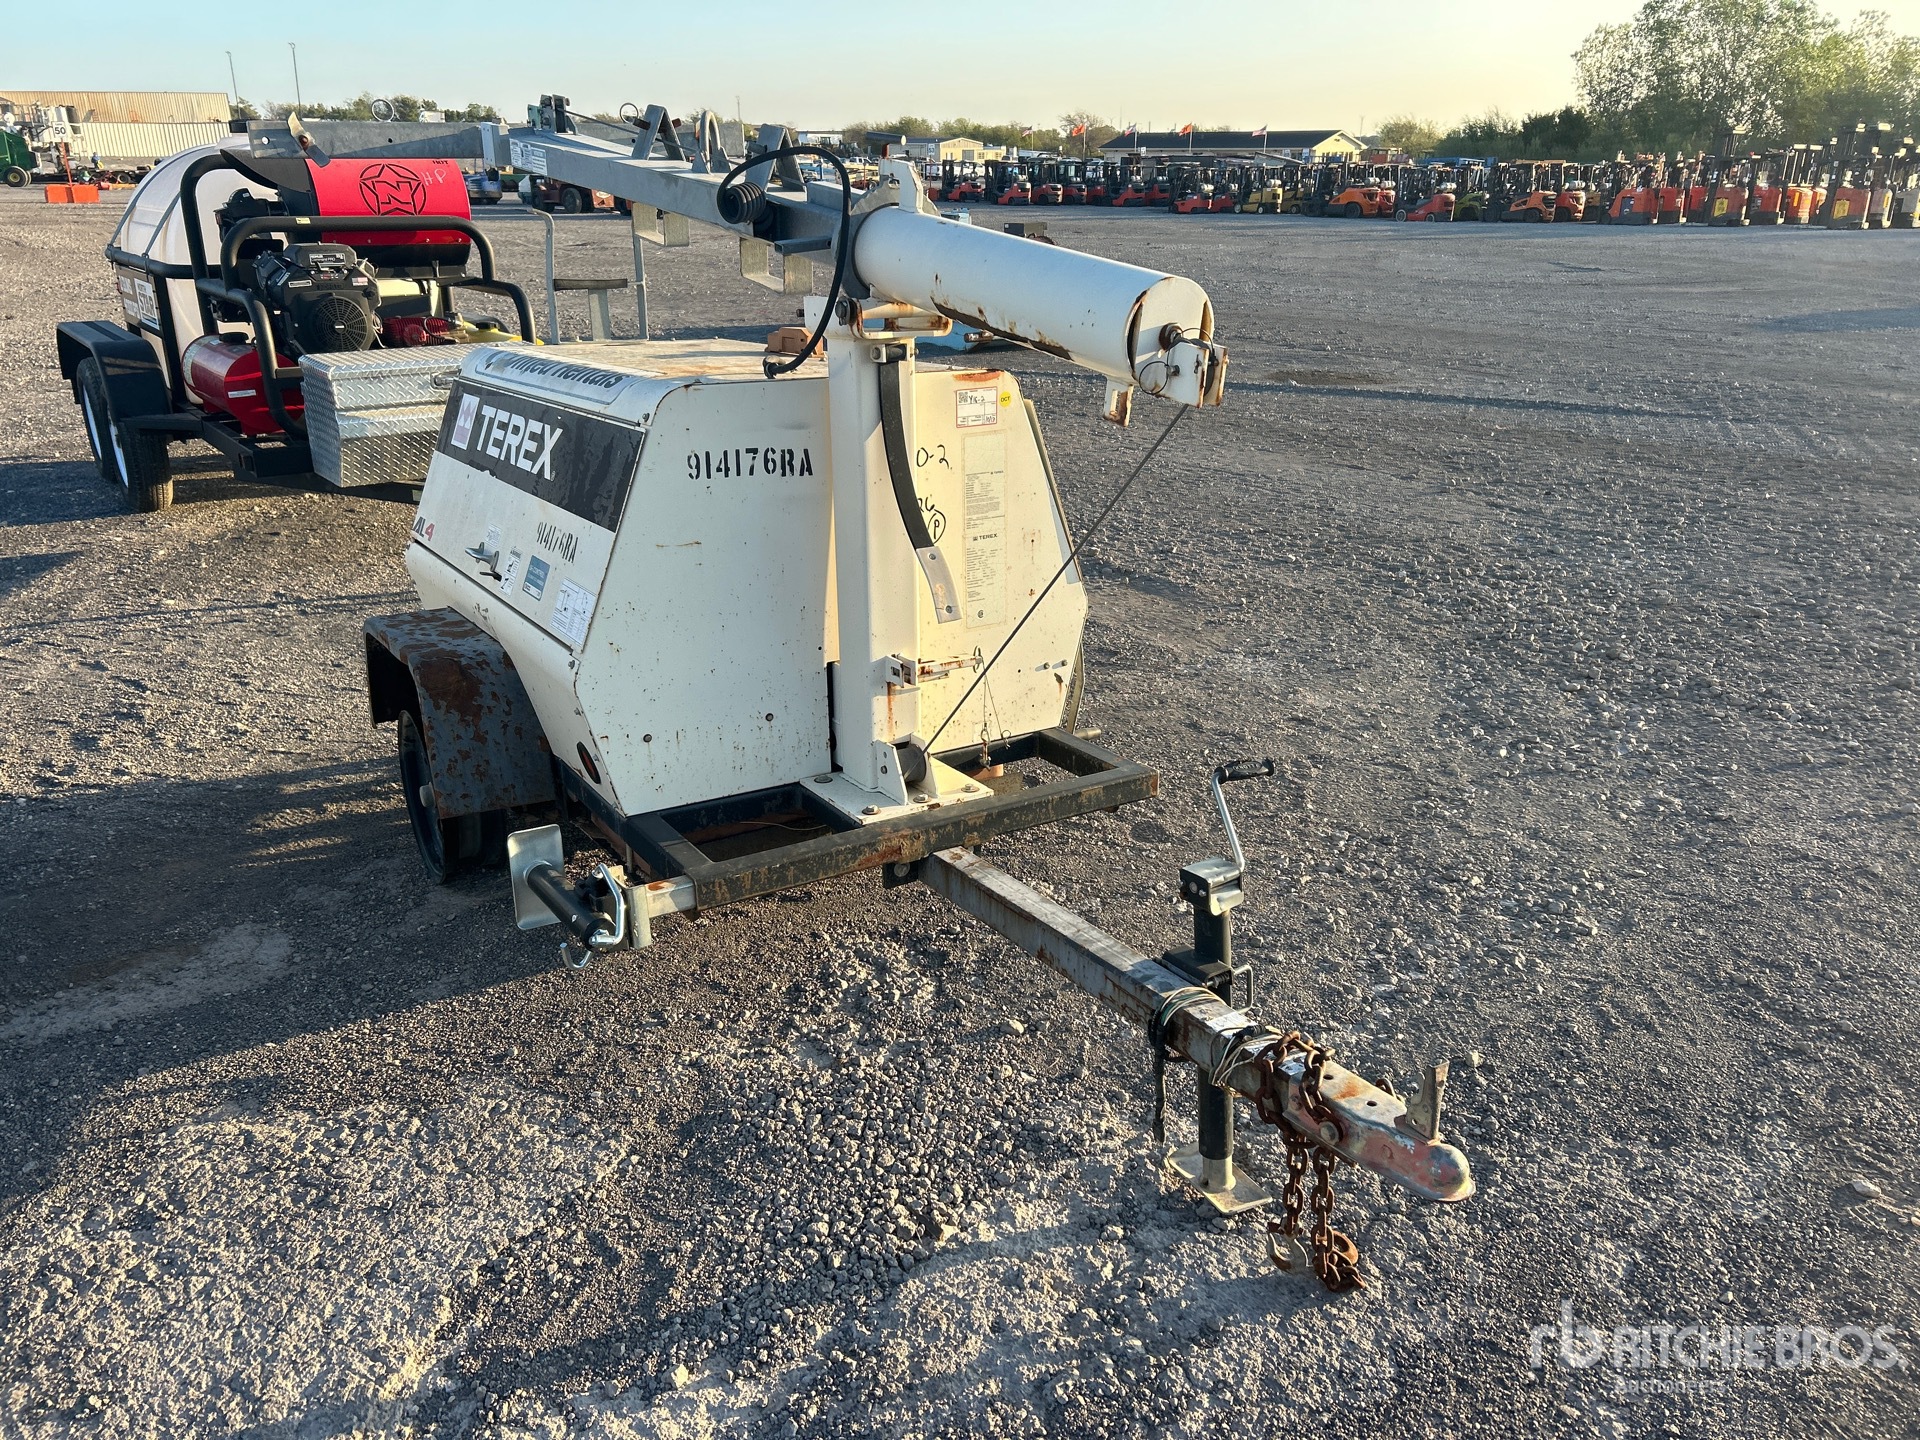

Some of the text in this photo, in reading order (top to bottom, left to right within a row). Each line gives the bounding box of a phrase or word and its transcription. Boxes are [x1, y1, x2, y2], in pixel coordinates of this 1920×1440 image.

[54, 127, 66, 135] 50
[477, 404, 563, 481] TEREX
[687, 447, 814, 480] 914176RA
[412, 516, 435, 542] AL4
[979, 532, 999, 540] TEREX
